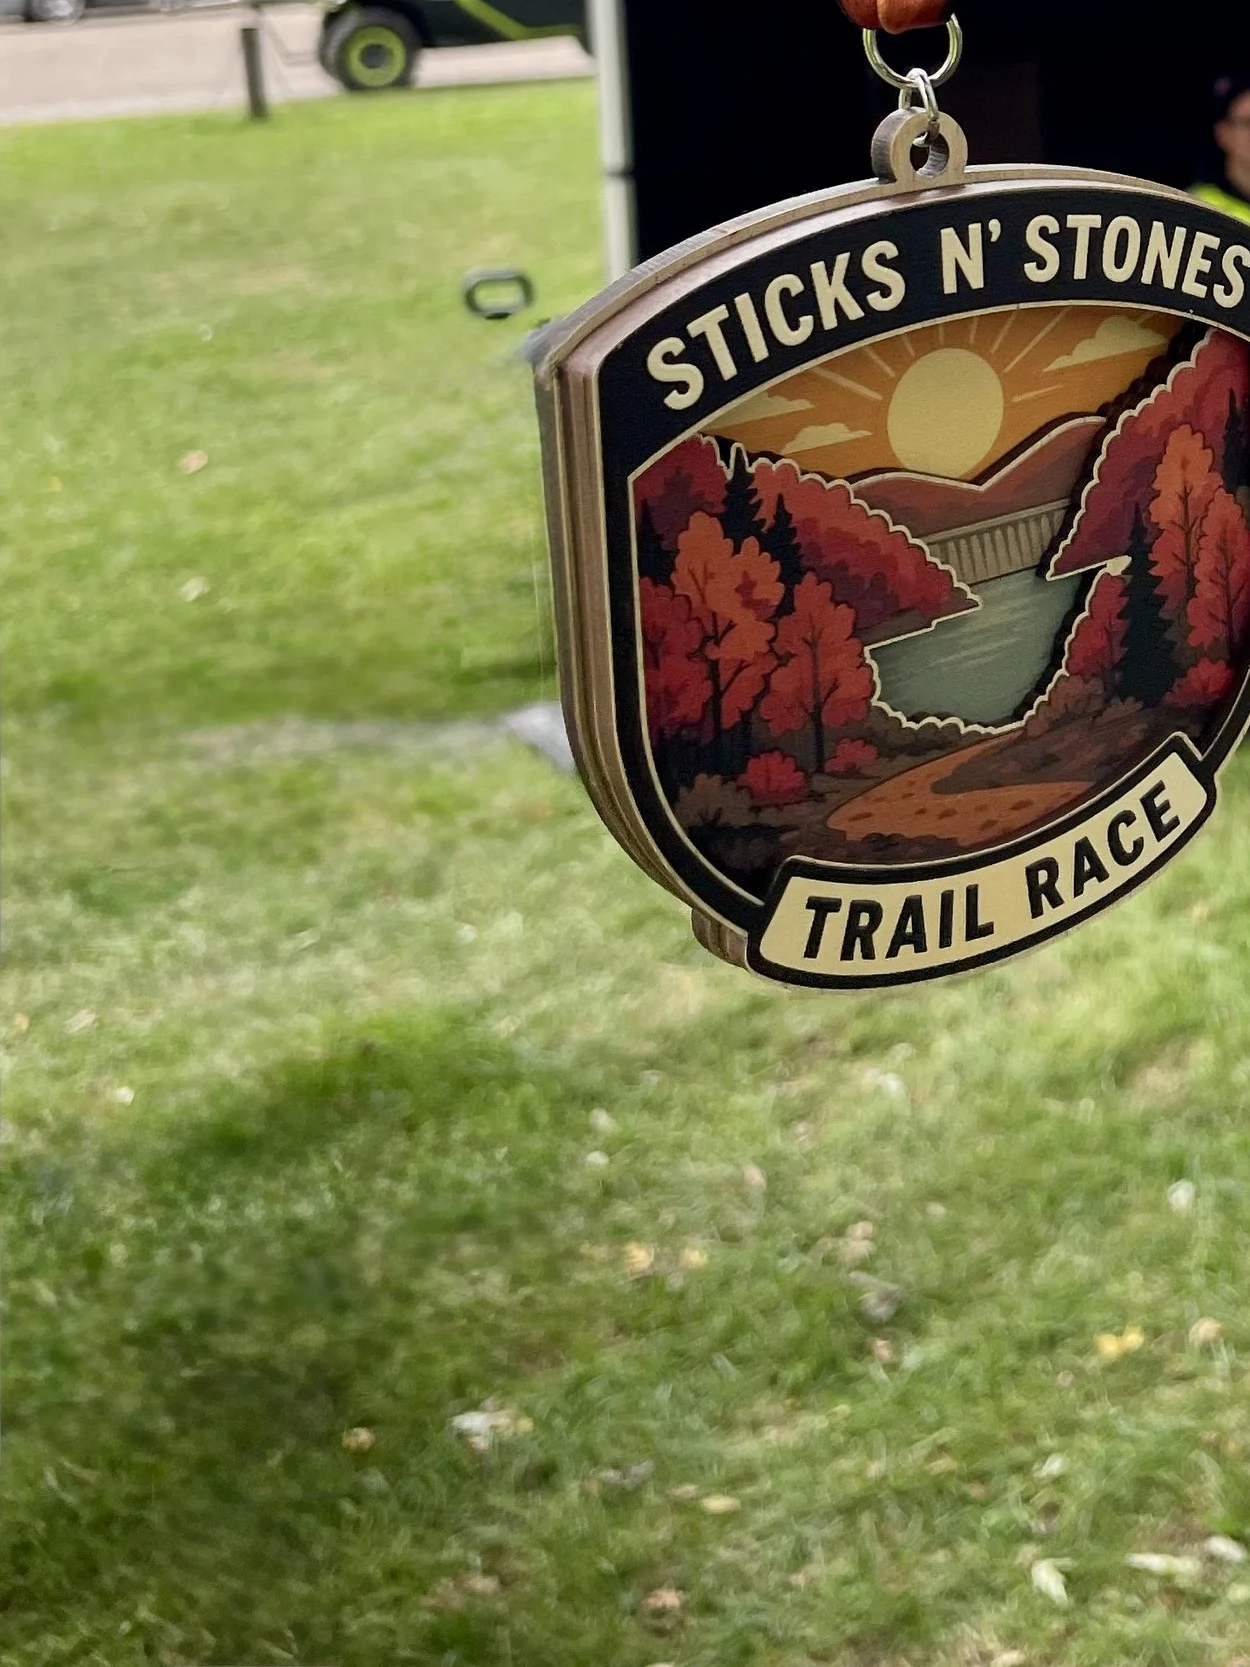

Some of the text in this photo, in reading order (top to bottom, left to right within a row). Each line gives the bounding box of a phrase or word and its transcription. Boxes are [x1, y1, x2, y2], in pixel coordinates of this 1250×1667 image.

[646, 239, 908, 412] STICKS
[801, 780, 1182, 962] TRAIL RACE
